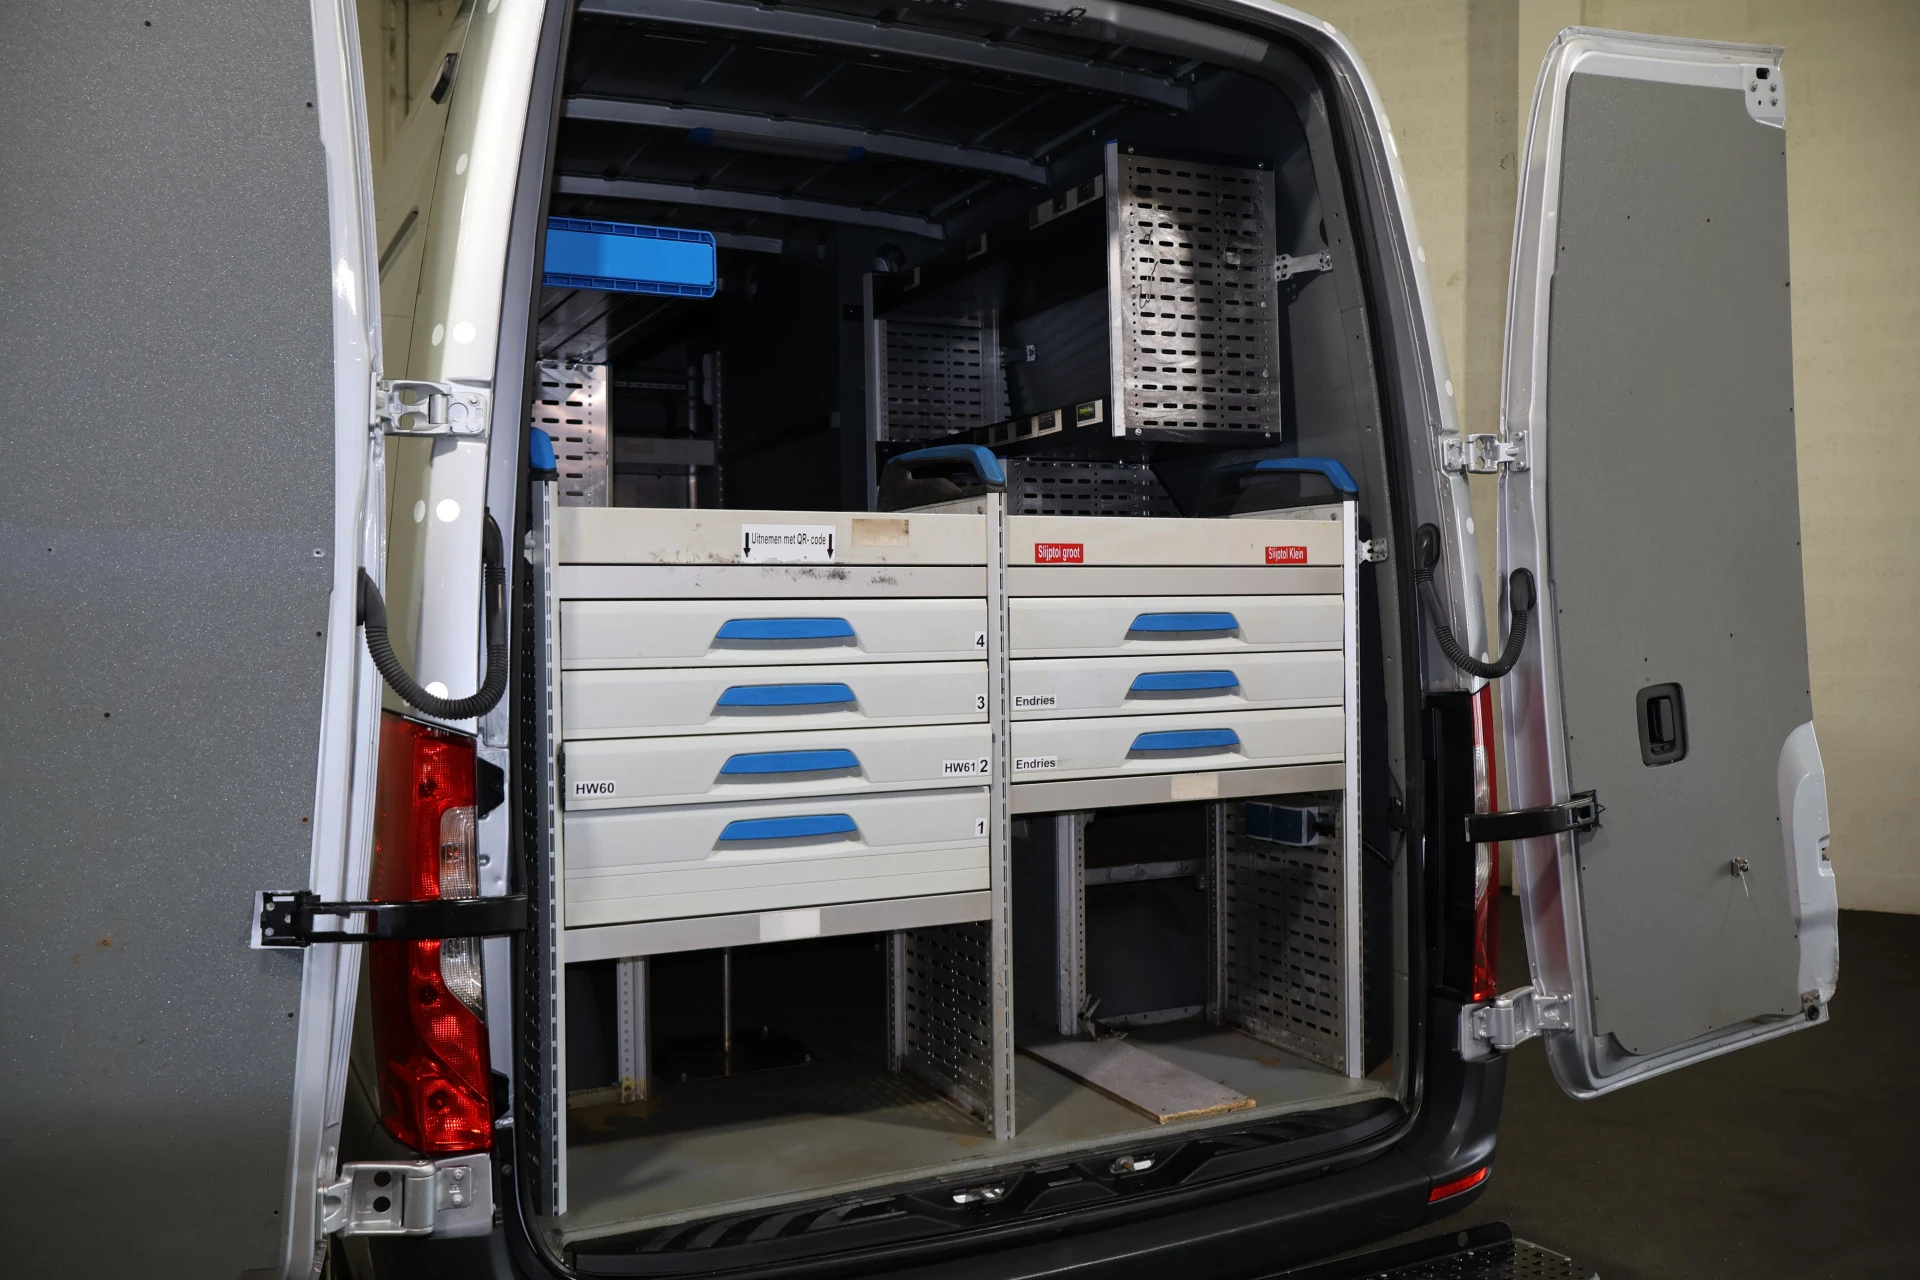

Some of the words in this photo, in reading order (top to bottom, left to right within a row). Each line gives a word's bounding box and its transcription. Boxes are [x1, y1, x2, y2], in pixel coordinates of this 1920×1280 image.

[751, 532, 782, 544] Uitnemen
[783, 535, 796, 545] met
[810, 533, 827, 545] code
[1038, 544, 1061, 561] Slijptol
[1062, 546, 1081, 561] groot
[1268, 547, 1288, 562] Slijptol
[1289, 547, 1304, 559] Klein
[976, 634, 985, 648] 4
[977, 696, 985, 709] 3
[1015, 695, 1055, 707] Endries
[944, 762, 976, 773] HW61
[980, 759, 989, 773] 2
[1016, 758, 1056, 770] Endries
[576, 782, 615, 795] HW60
[978, 821, 985, 835] 1
